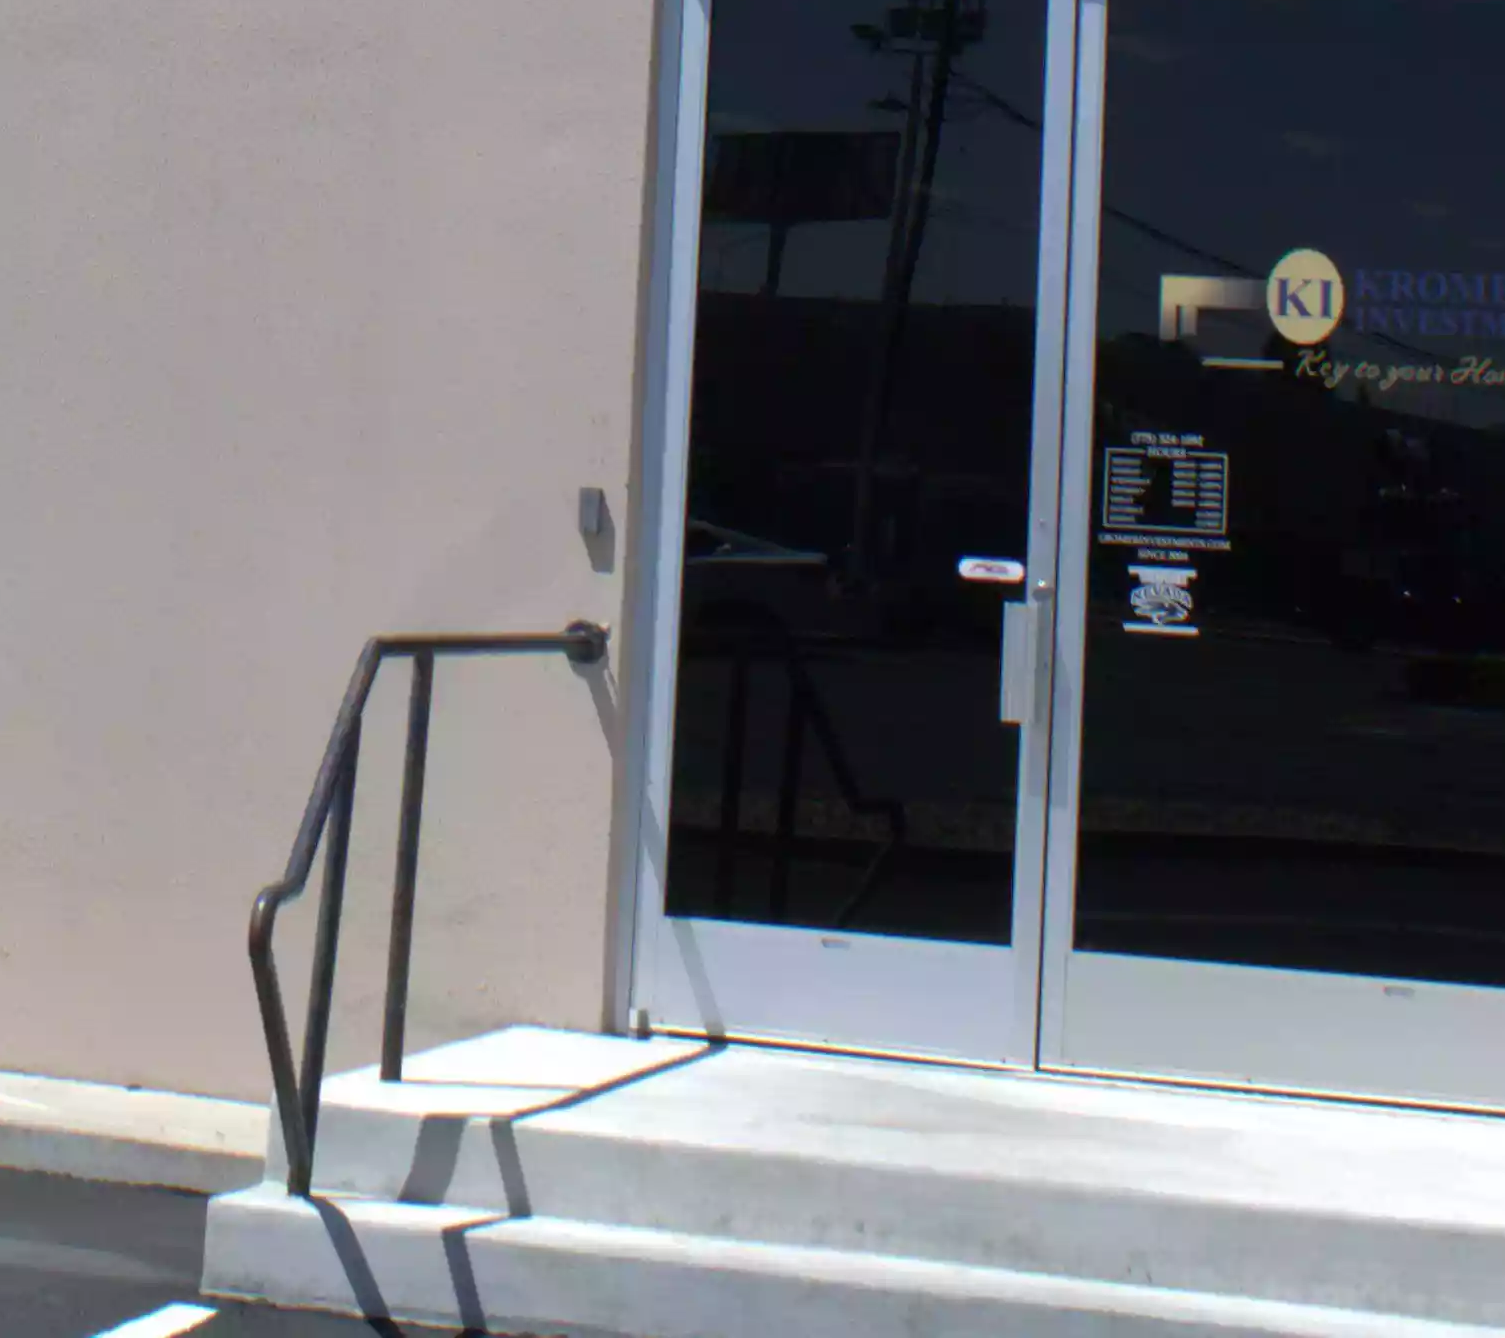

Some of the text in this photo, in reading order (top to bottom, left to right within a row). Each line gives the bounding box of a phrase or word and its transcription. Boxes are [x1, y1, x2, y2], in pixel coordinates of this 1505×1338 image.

[1274, 277, 1334, 320] KI
[1295, 349, 1350, 388] Key
[1354, 360, 1380, 380] to
[1380, 362, 1445, 390] your
